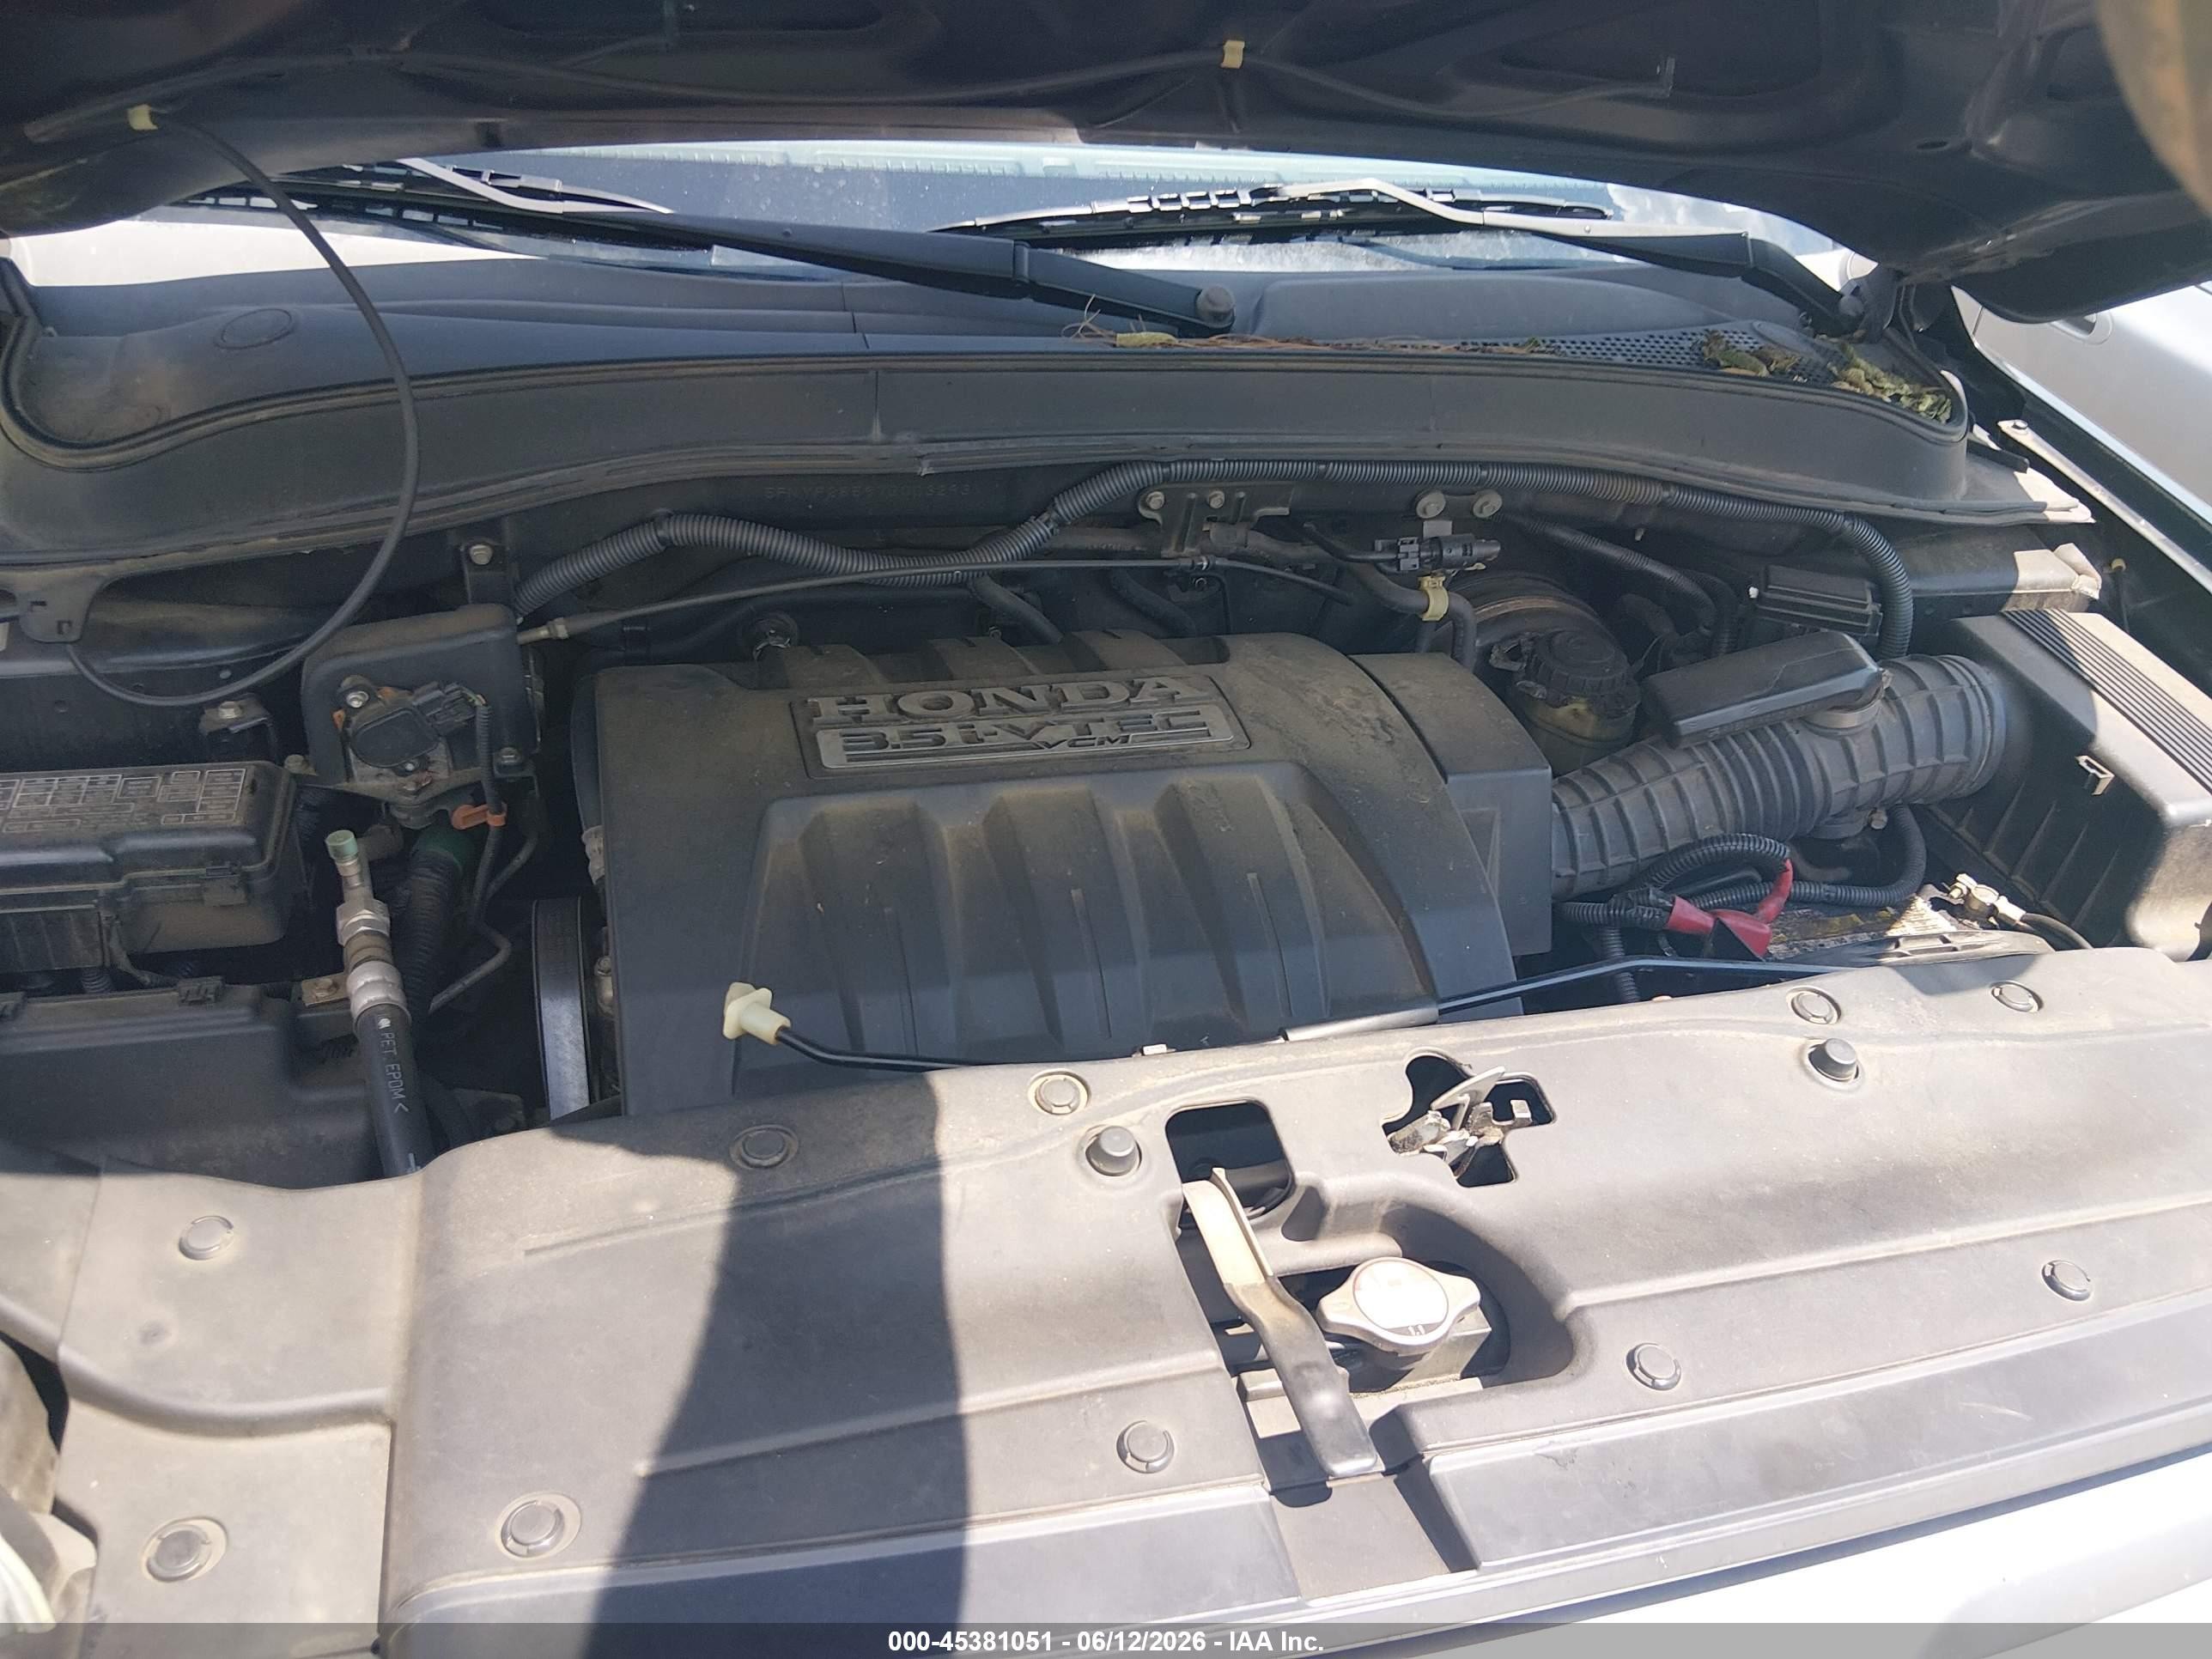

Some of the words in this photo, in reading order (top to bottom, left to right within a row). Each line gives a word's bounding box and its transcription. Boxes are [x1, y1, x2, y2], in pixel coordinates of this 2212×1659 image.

[807, 675, 1212, 726] HONDA
[839, 727, 946, 752] 3.5
[1033, 734, 1131, 750] VCM
[380, 1032, 398, 1055] PET
